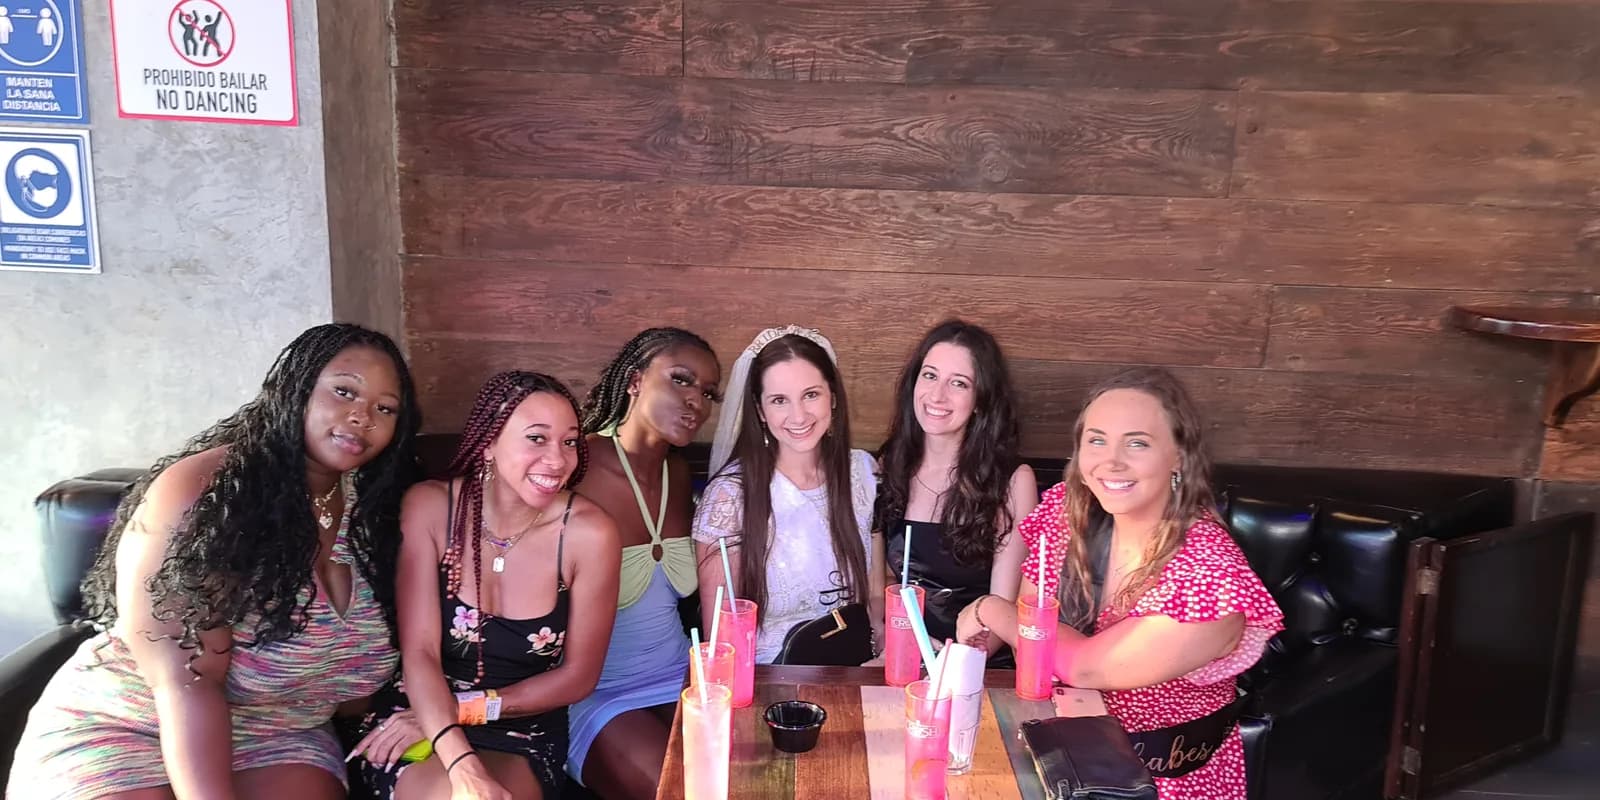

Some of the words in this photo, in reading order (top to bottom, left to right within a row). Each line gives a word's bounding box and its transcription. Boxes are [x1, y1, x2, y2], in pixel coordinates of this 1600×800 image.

[6, 77, 53, 88] MANTEN
[143, 68, 216, 88] PROHIBIDO
[219, 71, 268, 91] BAILAR
[6, 88, 23, 99] LA
[23, 89, 55, 100] SANA
[2, 99, 62, 112] DISTANCIA
[156, 88, 179, 110] NO
[184, 90, 258, 114] DANCING
